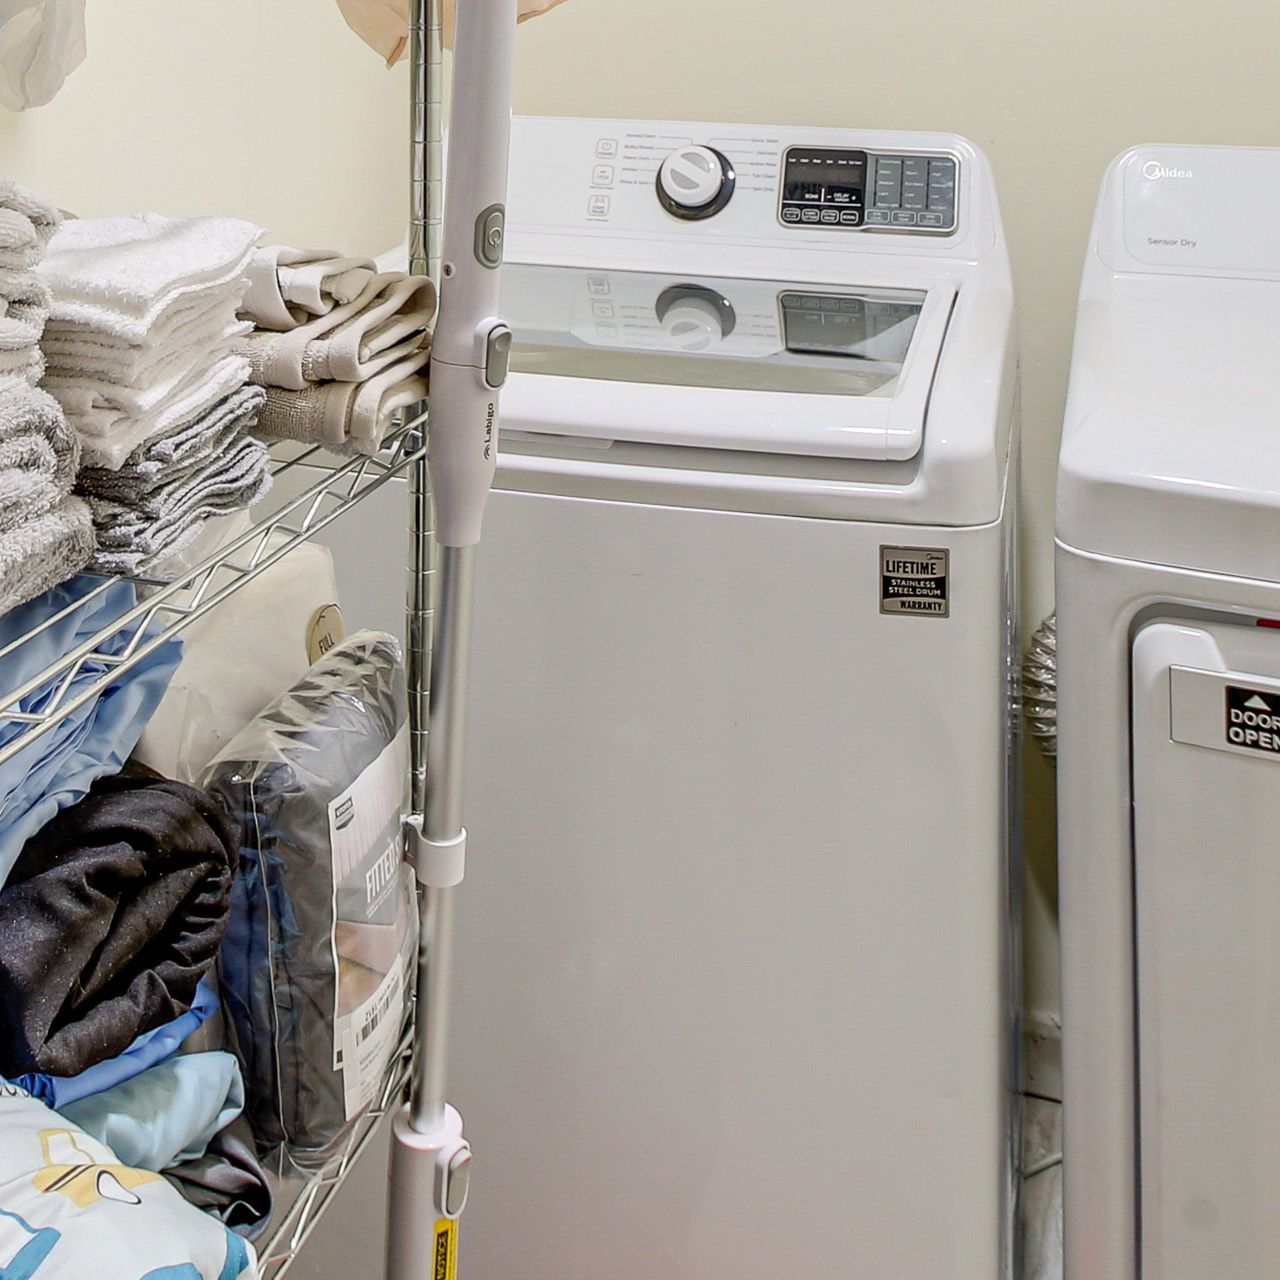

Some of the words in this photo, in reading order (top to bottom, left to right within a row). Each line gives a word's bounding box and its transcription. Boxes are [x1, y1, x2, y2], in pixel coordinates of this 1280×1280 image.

[1147, 236, 1178, 247] Sensor
[1180, 237, 1197, 249] Dry
[484, 402, 495, 444] Labigo
[885, 559, 937, 576] LIFETIME
[891, 579, 937, 588] STAINLESS
[888, 586, 915, 595] STEEL
[916, 587, 941, 597] DRUM
[899, 600, 943, 612] WARRANTY
[365, 840, 396, 904] FITTED
